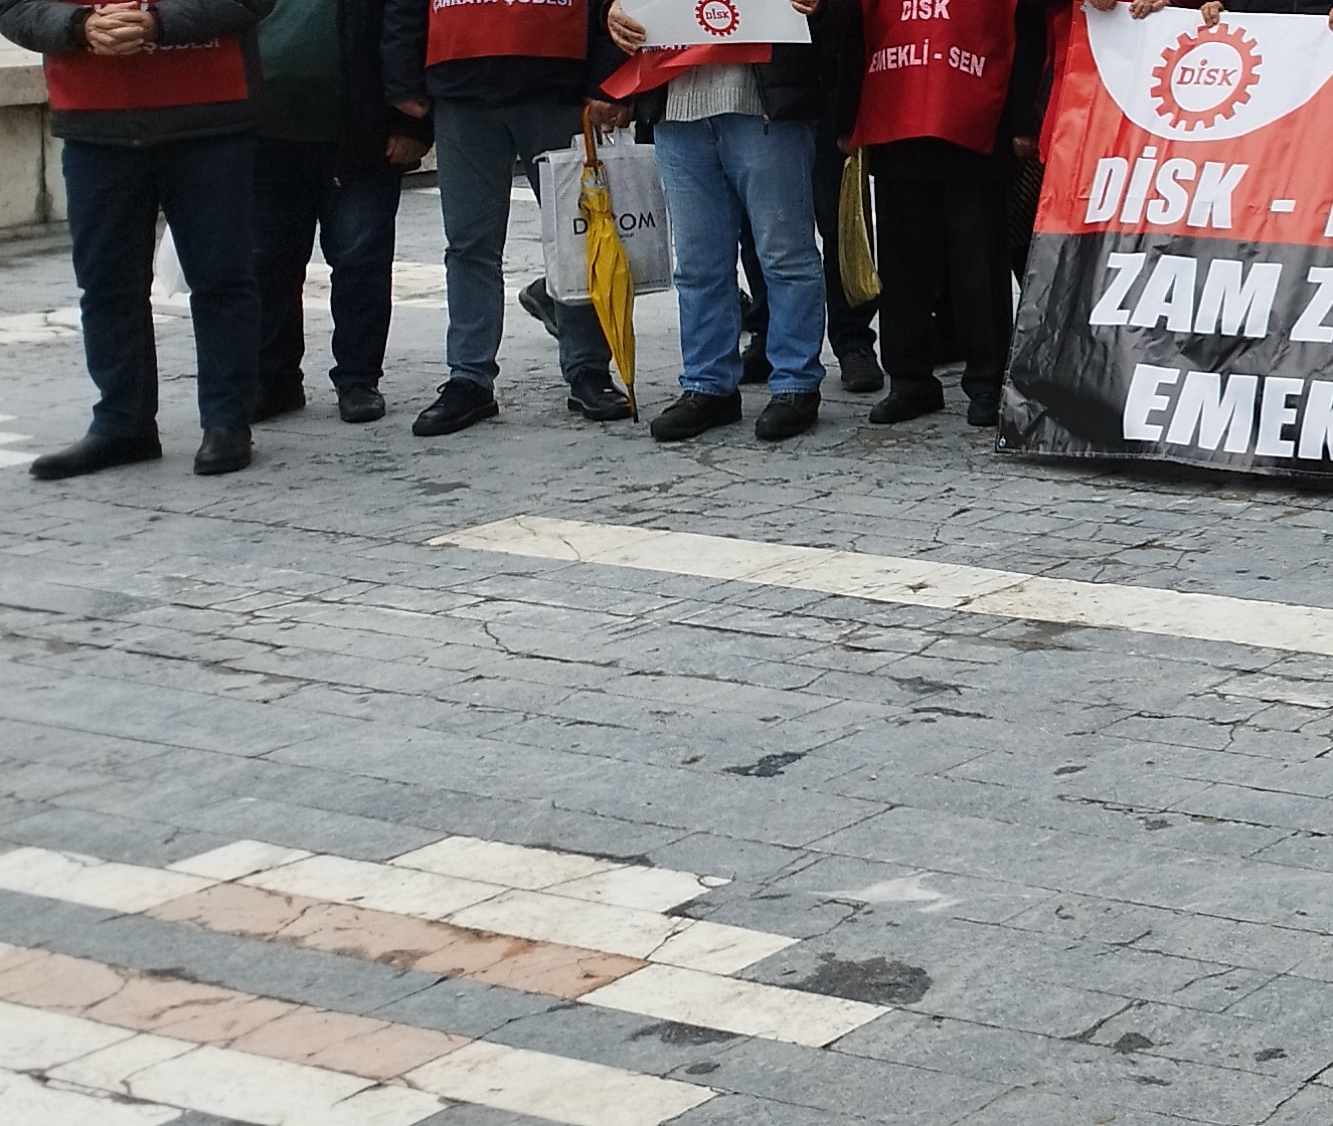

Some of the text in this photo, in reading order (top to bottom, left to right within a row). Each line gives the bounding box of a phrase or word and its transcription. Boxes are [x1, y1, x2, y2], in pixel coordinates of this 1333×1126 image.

[704, 7, 730, 21] DİSK
[868, 38, 930, 74] EMEKLİ
[948, 45, 987, 78] SEN
[1176, 58, 1238, 87] DİSK
[1084, 145, 1248, 229] DİSK
[1269, 199, 1296, 213] -
[1088, 251, 1283, 339] ZAM
